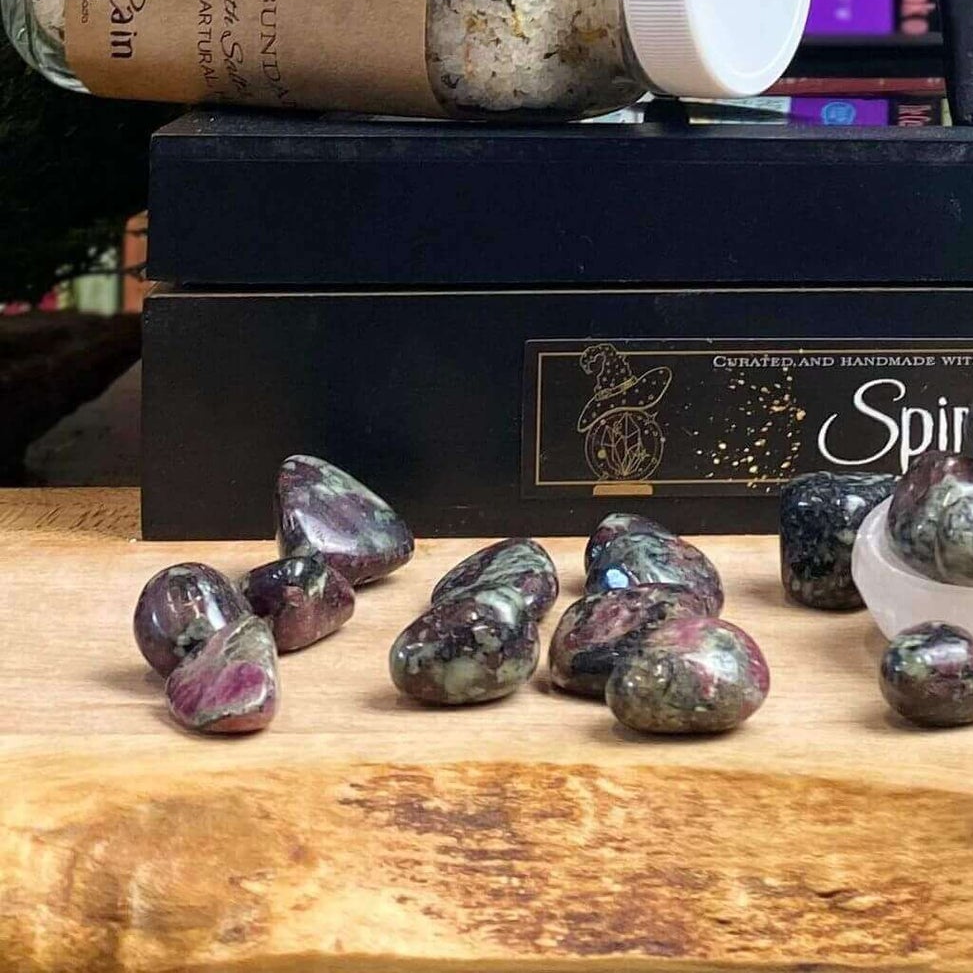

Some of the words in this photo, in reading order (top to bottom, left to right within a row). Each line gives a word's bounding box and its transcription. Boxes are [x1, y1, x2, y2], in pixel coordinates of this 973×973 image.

[712, 354, 794, 368] CURATED
[797, 356, 836, 368] AND
[840, 356, 936, 368] HANDMADE
